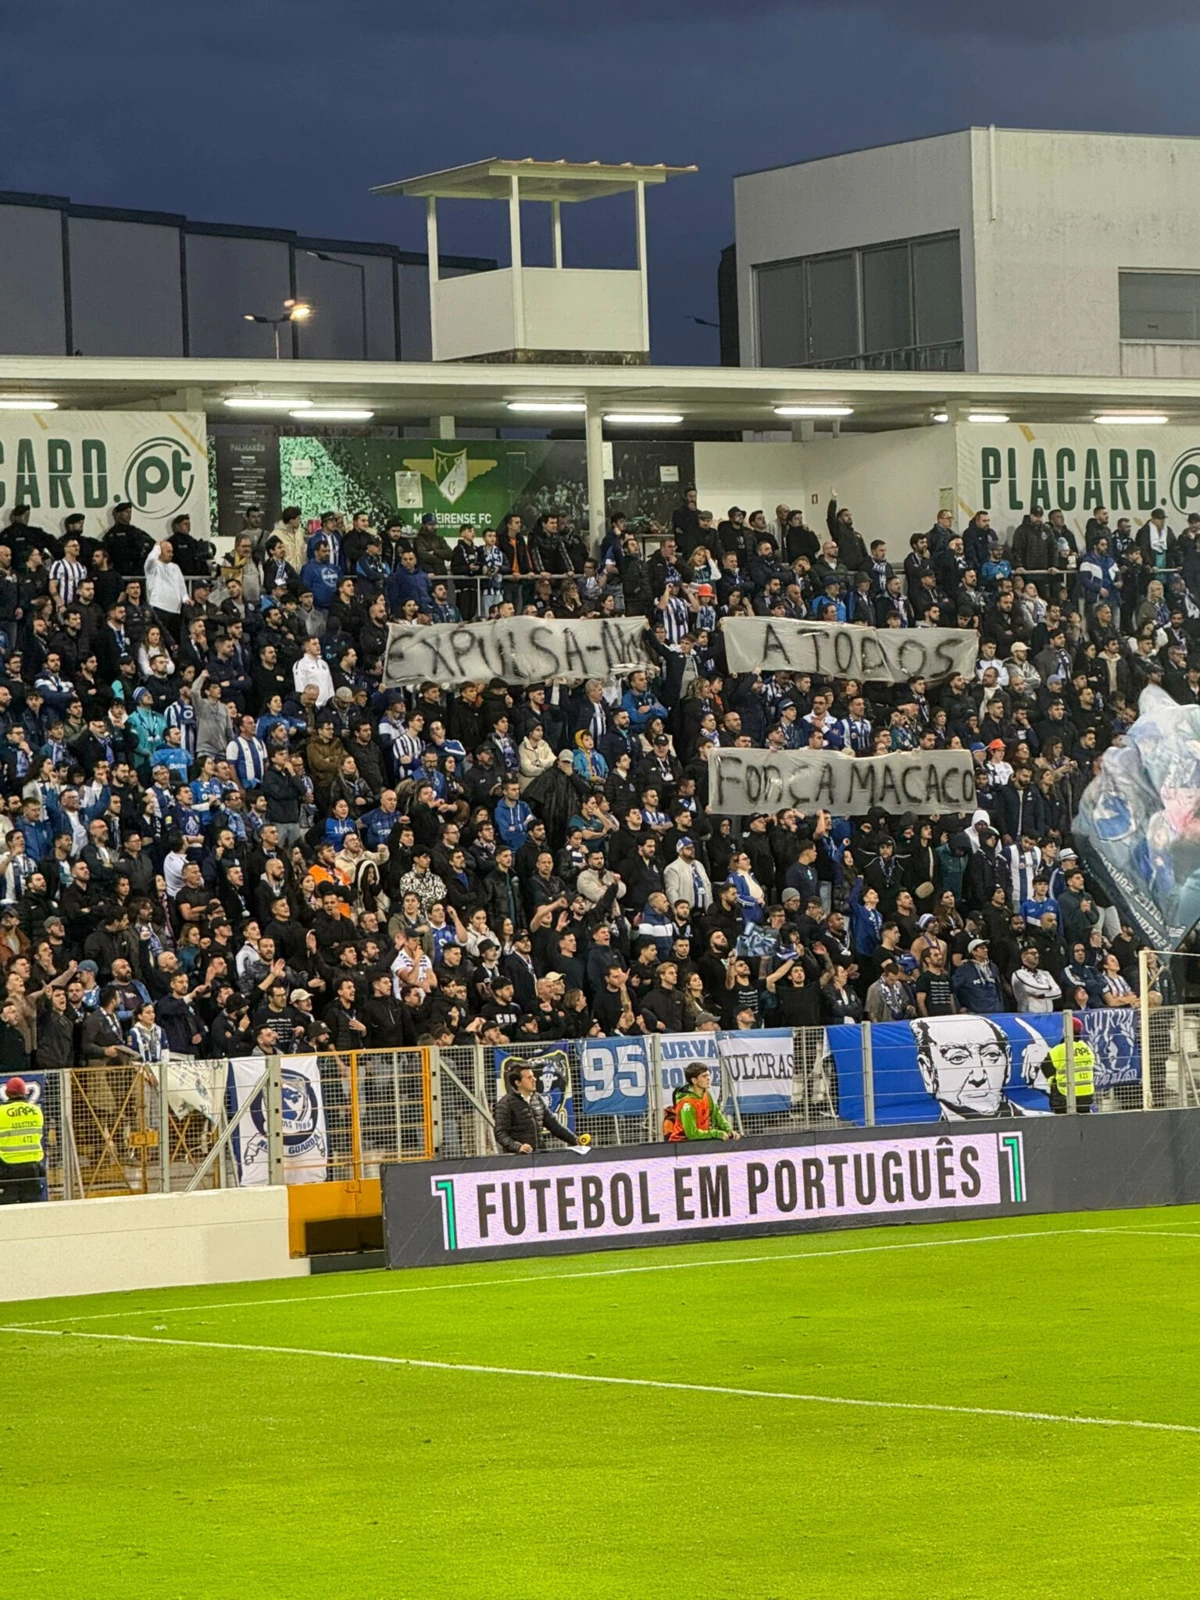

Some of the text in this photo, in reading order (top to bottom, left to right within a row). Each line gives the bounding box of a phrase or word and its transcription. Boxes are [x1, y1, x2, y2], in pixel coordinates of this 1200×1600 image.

[413, 512, 492, 525] MEIRENSE FC
[763, 624, 963, 679] A TODOS
[848, 763, 975, 805] MACACO
[660, 1039, 719, 1060] URVA
[726, 1053, 793, 1081] ULTRAS
[582, 1044, 648, 1102] 95
[288, 1133, 321, 1154] GUARDA
[476, 1136, 981, 1239] FUTEBOL EM PORTUGUÊS
